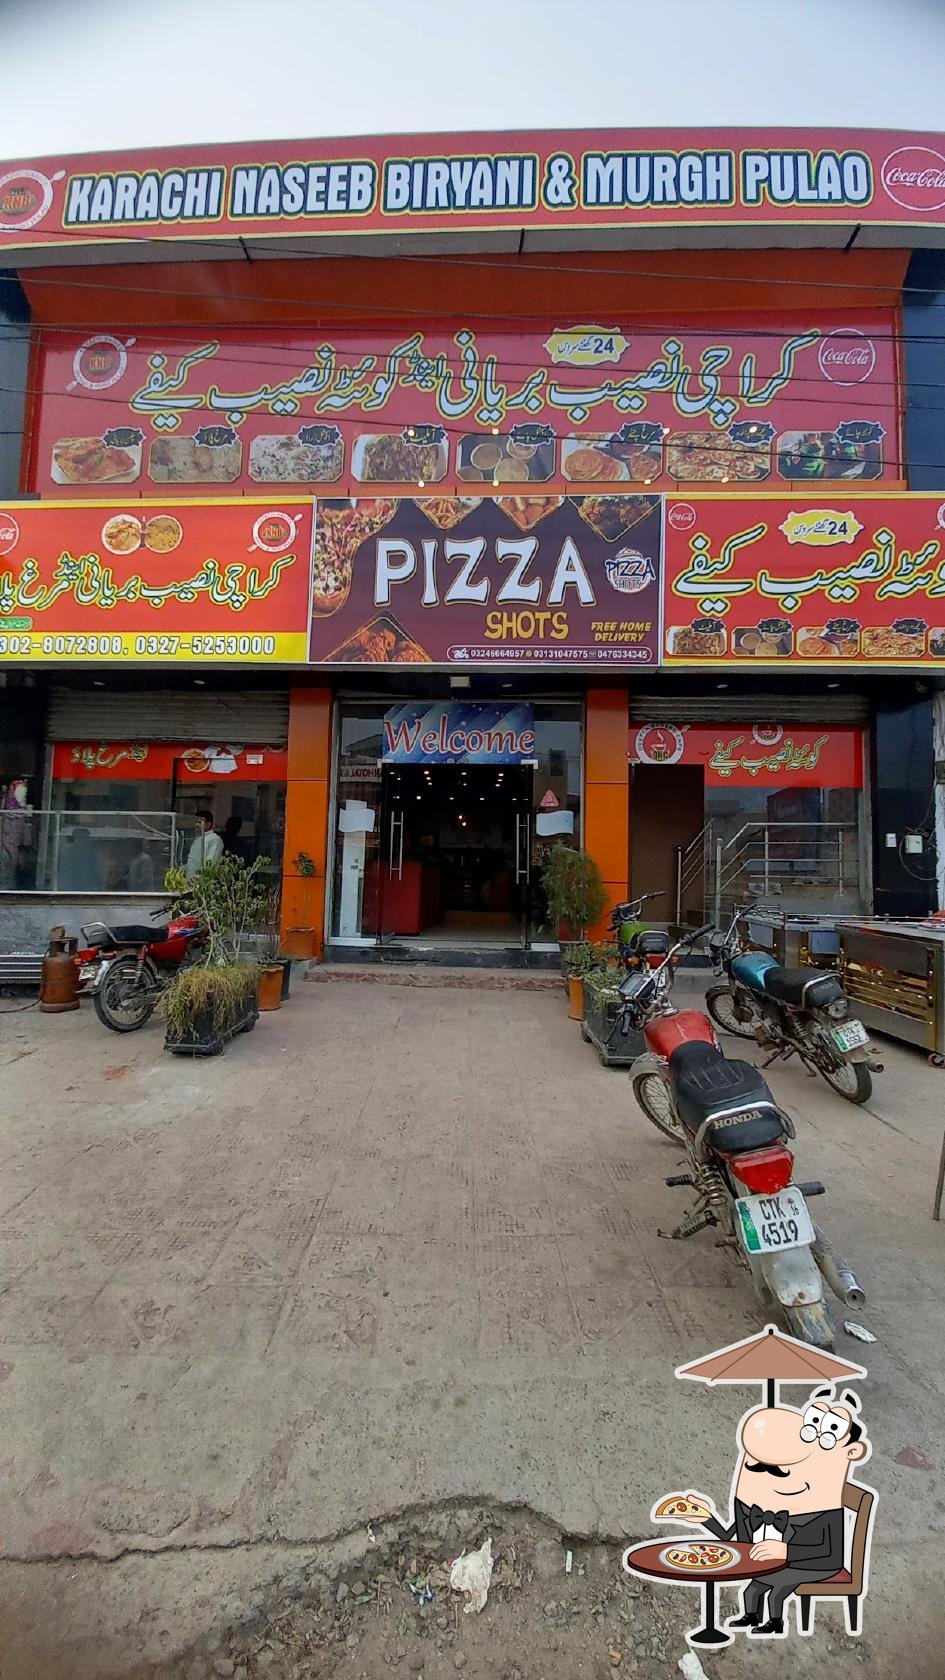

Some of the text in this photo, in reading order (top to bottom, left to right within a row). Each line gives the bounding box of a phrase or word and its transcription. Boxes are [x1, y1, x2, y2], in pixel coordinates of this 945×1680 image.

[65, 168, 223, 224] KARACHI
[232, 160, 375, 216] NASEEB
[384, 156, 537, 213] BIRYANI
[546, 155, 577, 206] &
[584, 153, 733, 206] MURGH
[744, 152, 871, 204] PULAO
[594, 338, 614, 354] 24
[209, 345, 335, 425] نصیب
[438, 330, 546, 424] بریانی
[549, 339, 682, 420] نصیب
[677, 330, 819, 427] کراچی
[828, 520, 848, 536] 24
[76, 554, 139, 609] بریانی
[139, 560, 217, 606] نصیب
[212, 554, 296, 610] کراچی
[374, 537, 598, 606] PIZZA
[605, 558, 656, 580] PIZZA
[757, 529, 894, 614] نصیب
[135, 635, 276, 655] 0327-5253000
[484, 611, 569, 640] SHOTS
[590, 621, 652, 632] FREE HOME
[594, 632, 645, 642] DELIVERY
[384, 714, 535, 755] Welcome
[714, 1110, 762, 1130] HONDA
[759, 1197, 786, 1221] CTK
[762, 1219, 799, 1246] 4519
